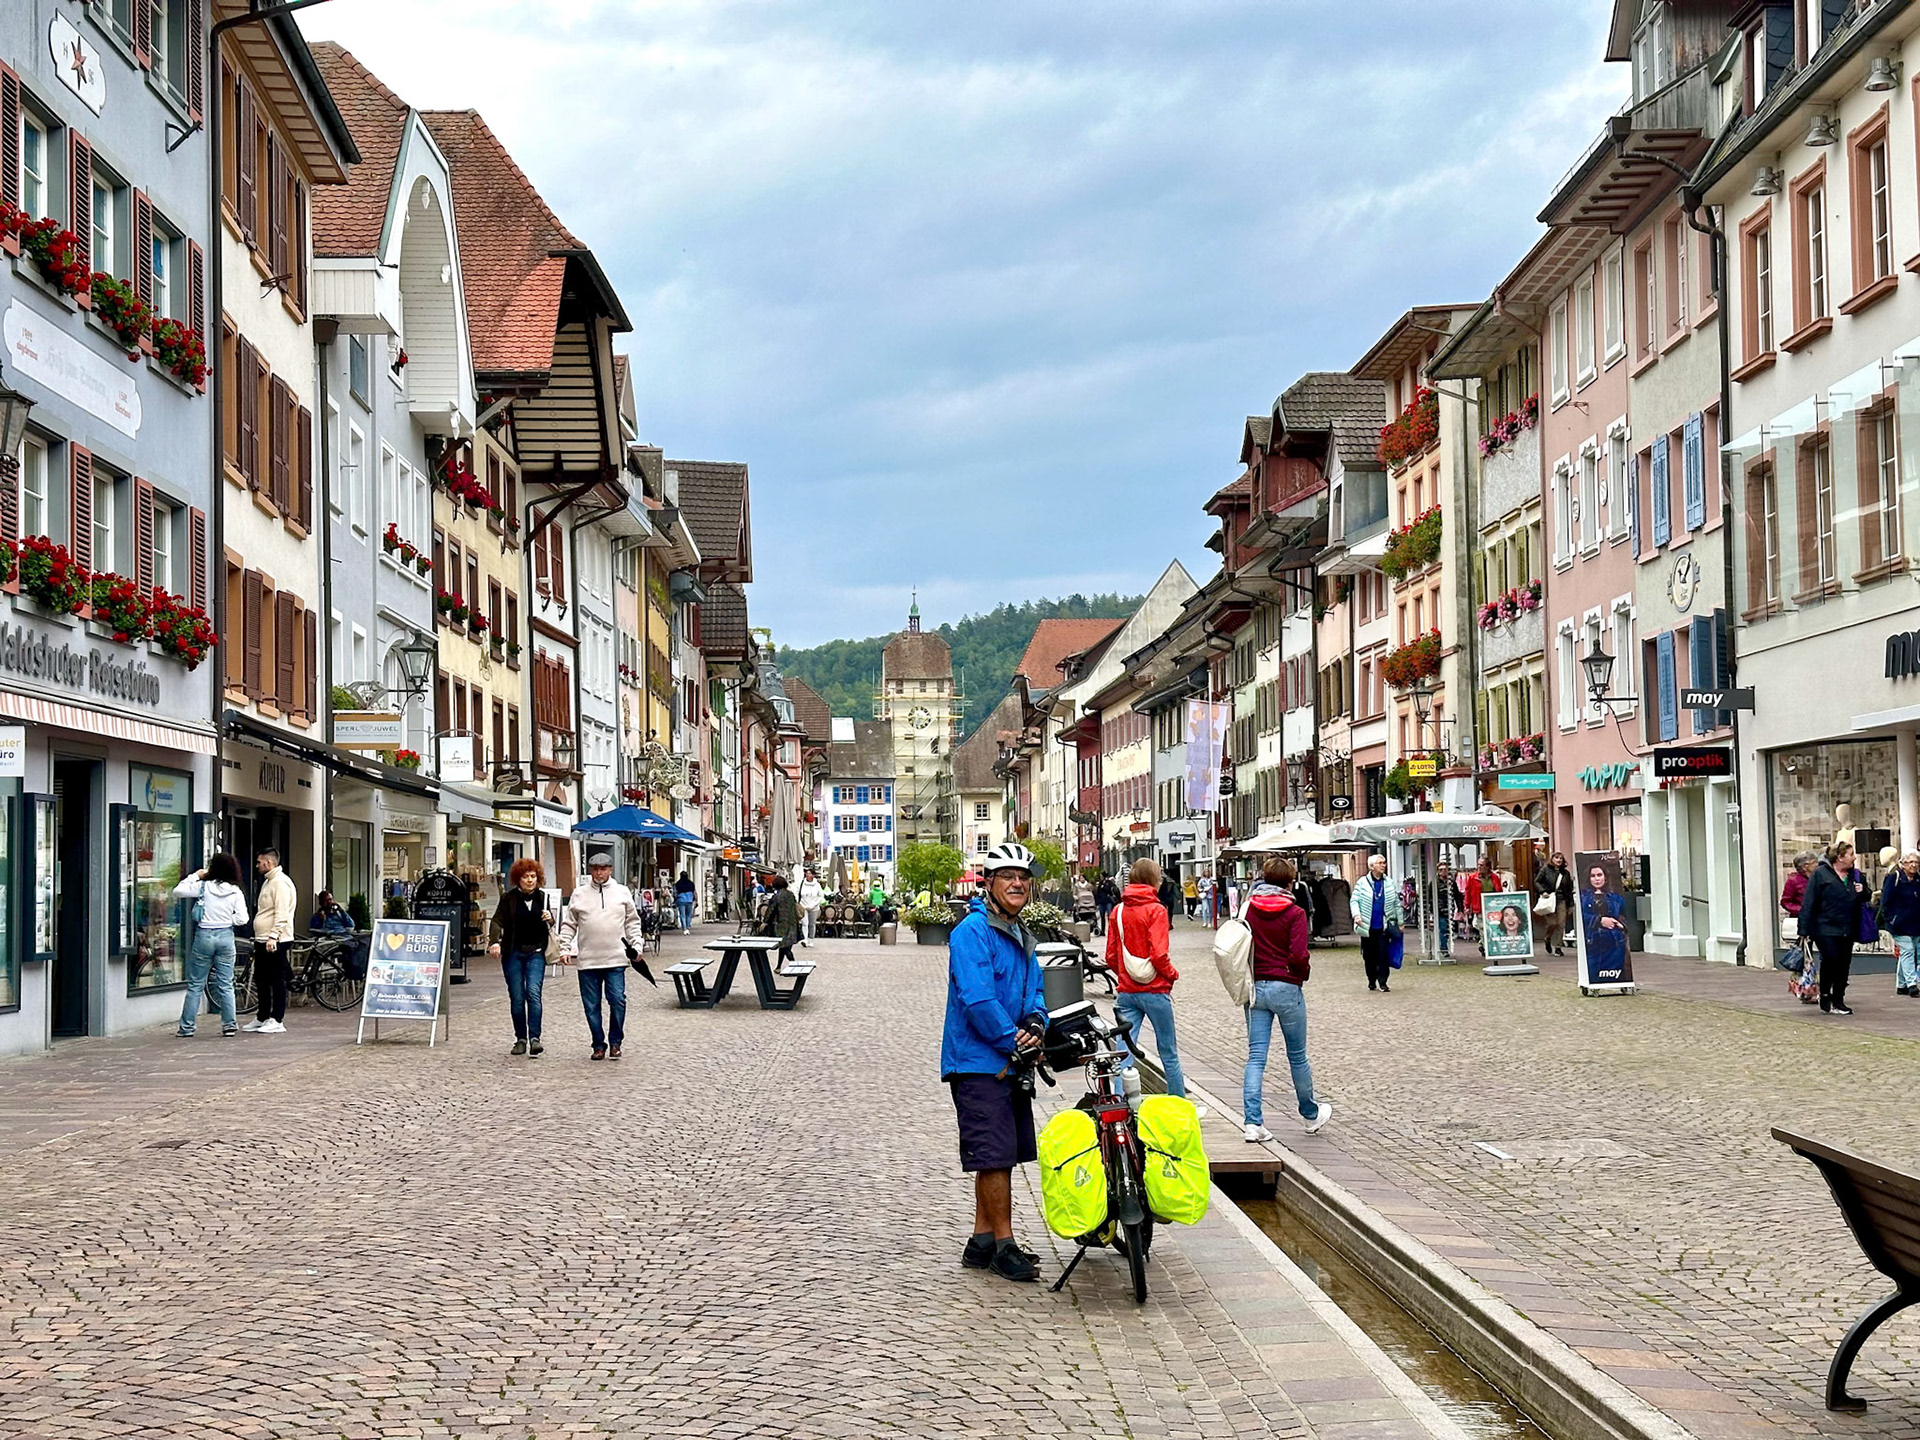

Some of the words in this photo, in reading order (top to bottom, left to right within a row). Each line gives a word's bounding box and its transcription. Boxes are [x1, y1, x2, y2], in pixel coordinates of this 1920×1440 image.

[89, 647, 161, 706] Reisebüro
[1686, 692, 1724, 707] may
[1661, 753, 1724, 770] prooptik
[1576, 761, 1641, 791] now
[1390, 823, 1428, 836] prooptik
[406, 933, 438, 944] REISE
[405, 943, 437, 954] BÜRO
[1598, 968, 1622, 979] may
